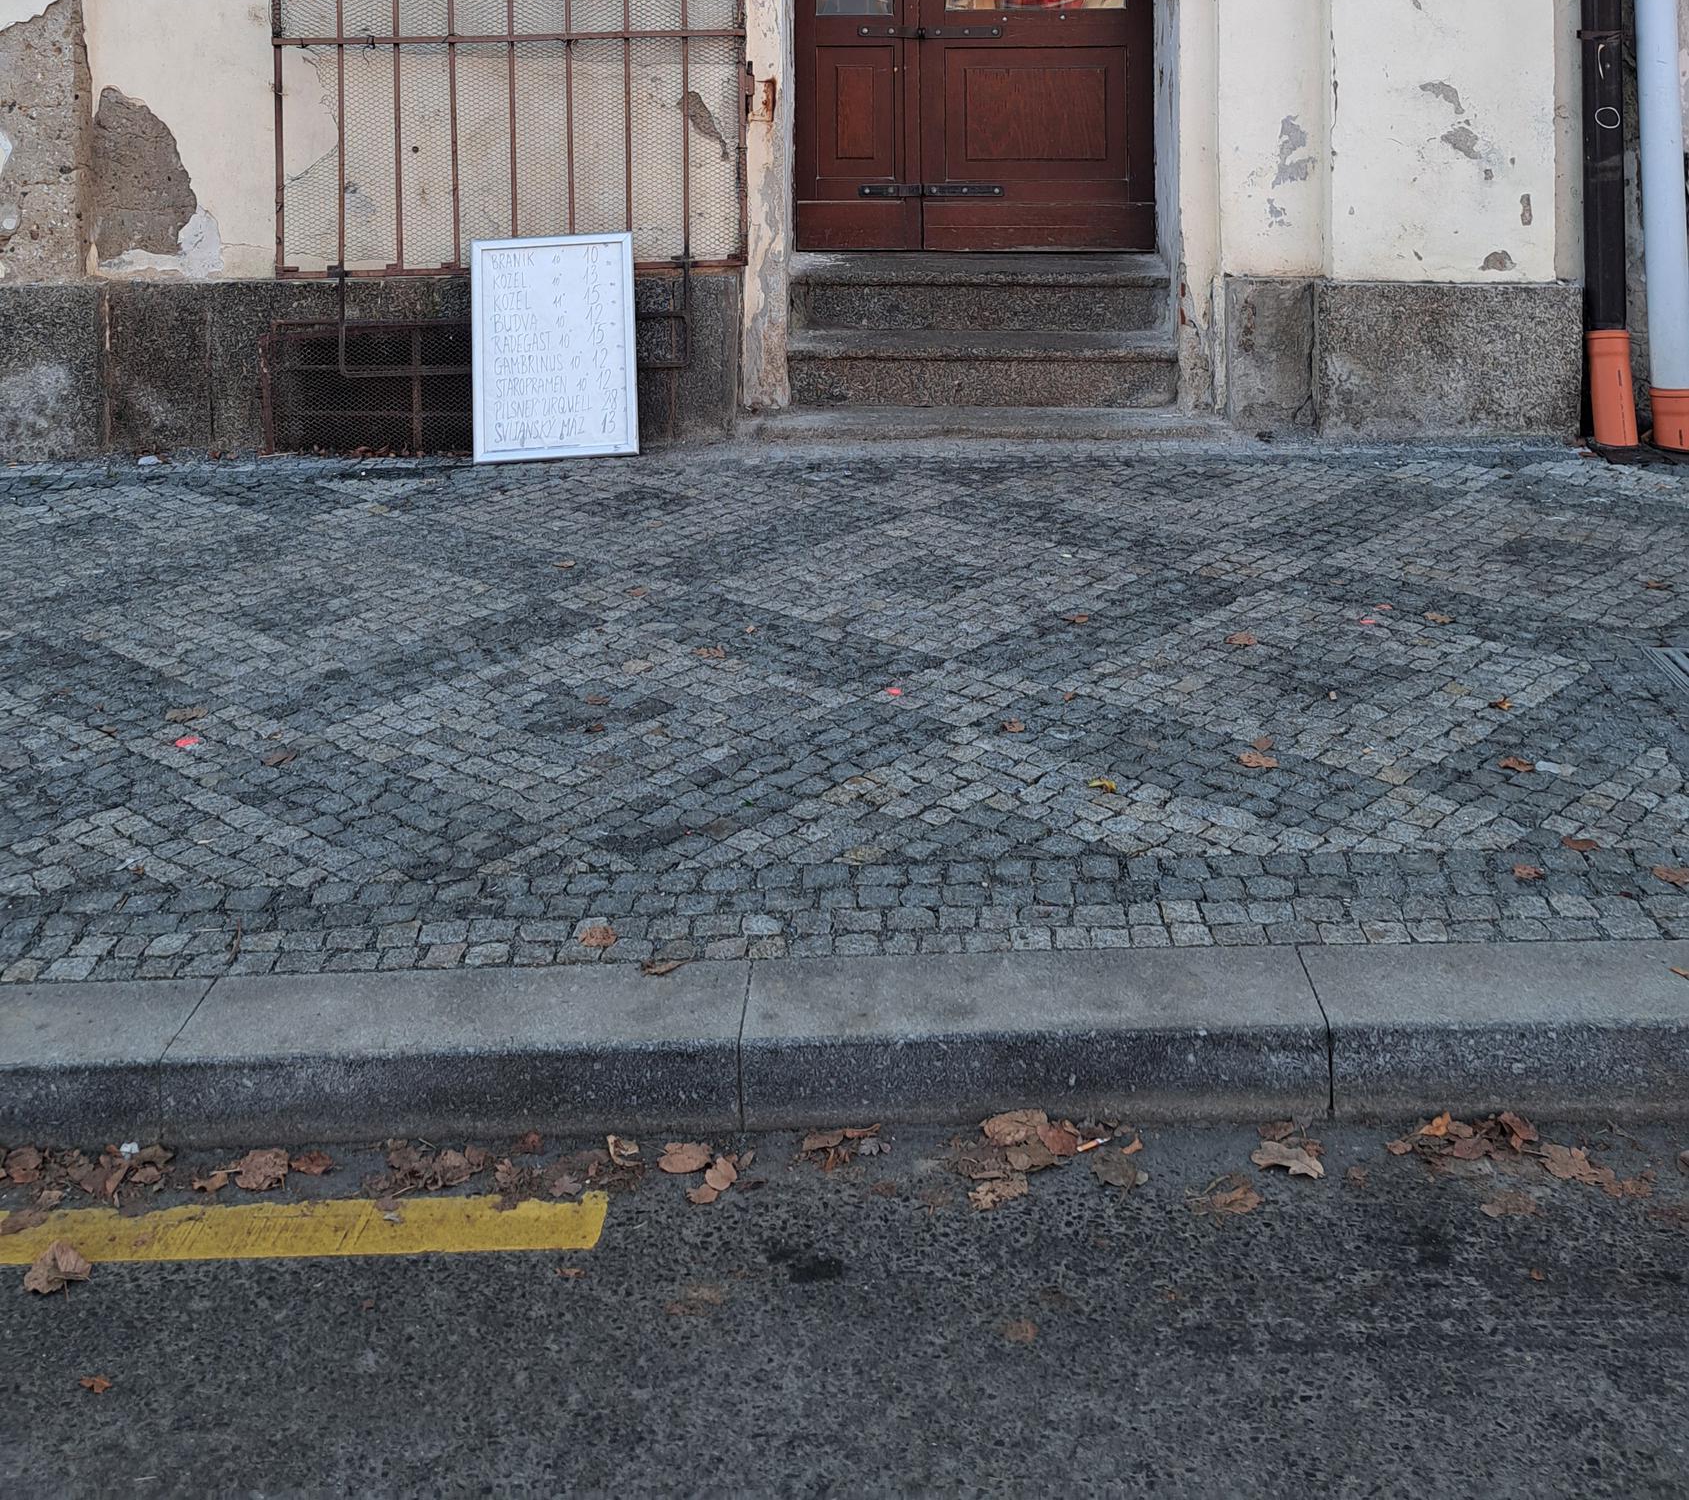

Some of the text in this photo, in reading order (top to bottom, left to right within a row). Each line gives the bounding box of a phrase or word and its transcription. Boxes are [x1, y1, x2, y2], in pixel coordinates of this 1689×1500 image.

[493, 290, 532, 312] KOZEL
[490, 312, 538, 333] BUDVA
[491, 331, 552, 354] RADEGAST
[494, 353, 564, 376] GAMBRINUS
[496, 375, 567, 398] STAROPRAMEN
